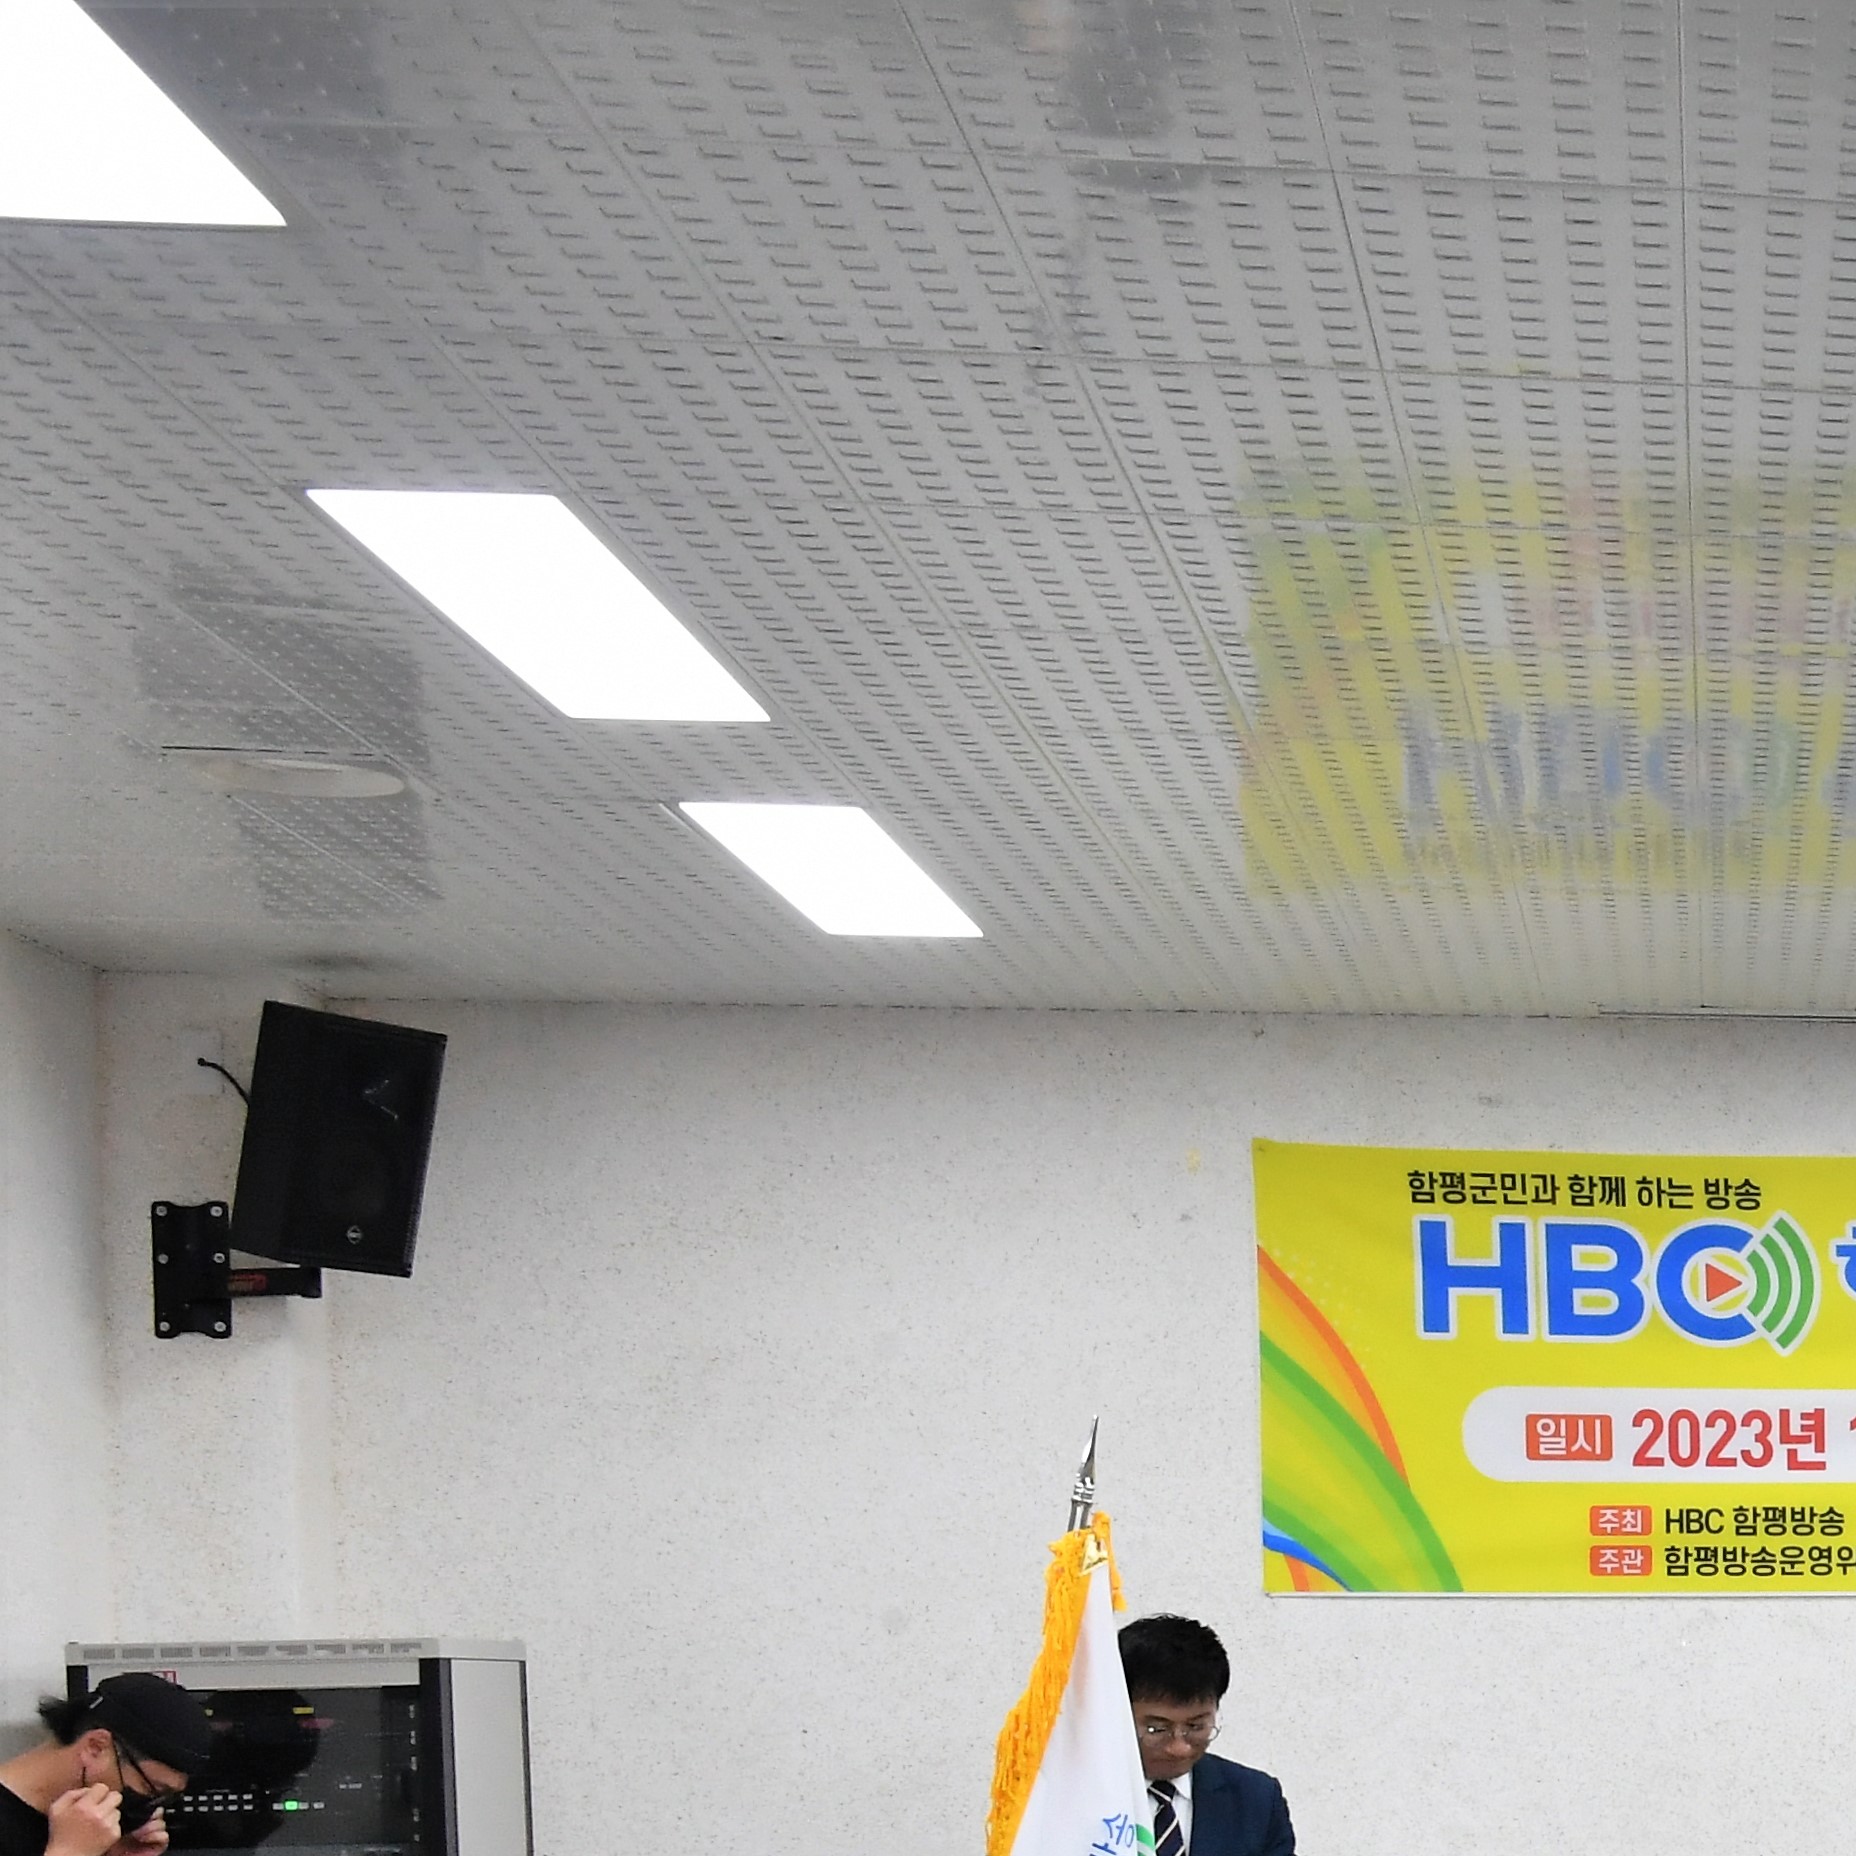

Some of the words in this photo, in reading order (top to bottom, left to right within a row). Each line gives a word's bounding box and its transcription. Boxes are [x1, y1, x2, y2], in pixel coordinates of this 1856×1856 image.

[1407, 1170, 1560, 1205] 함평군민과
[1567, 1174, 1628, 1208] 함께
[1636, 1176, 1694, 1209] 하는
[1704, 1178, 1762, 1212] 방송
[1421, 1220, 1764, 1340] HBC
[1532, 1416, 1606, 1458] 일시
[1632, 1408, 1826, 1472] 2023년
[1598, 1508, 1644, 1535] 주최
[1664, 1507, 1725, 1534] HBC
[1732, 1504, 1845, 1538] 함평방송
[1598, 1548, 1645, 1575] 주관
